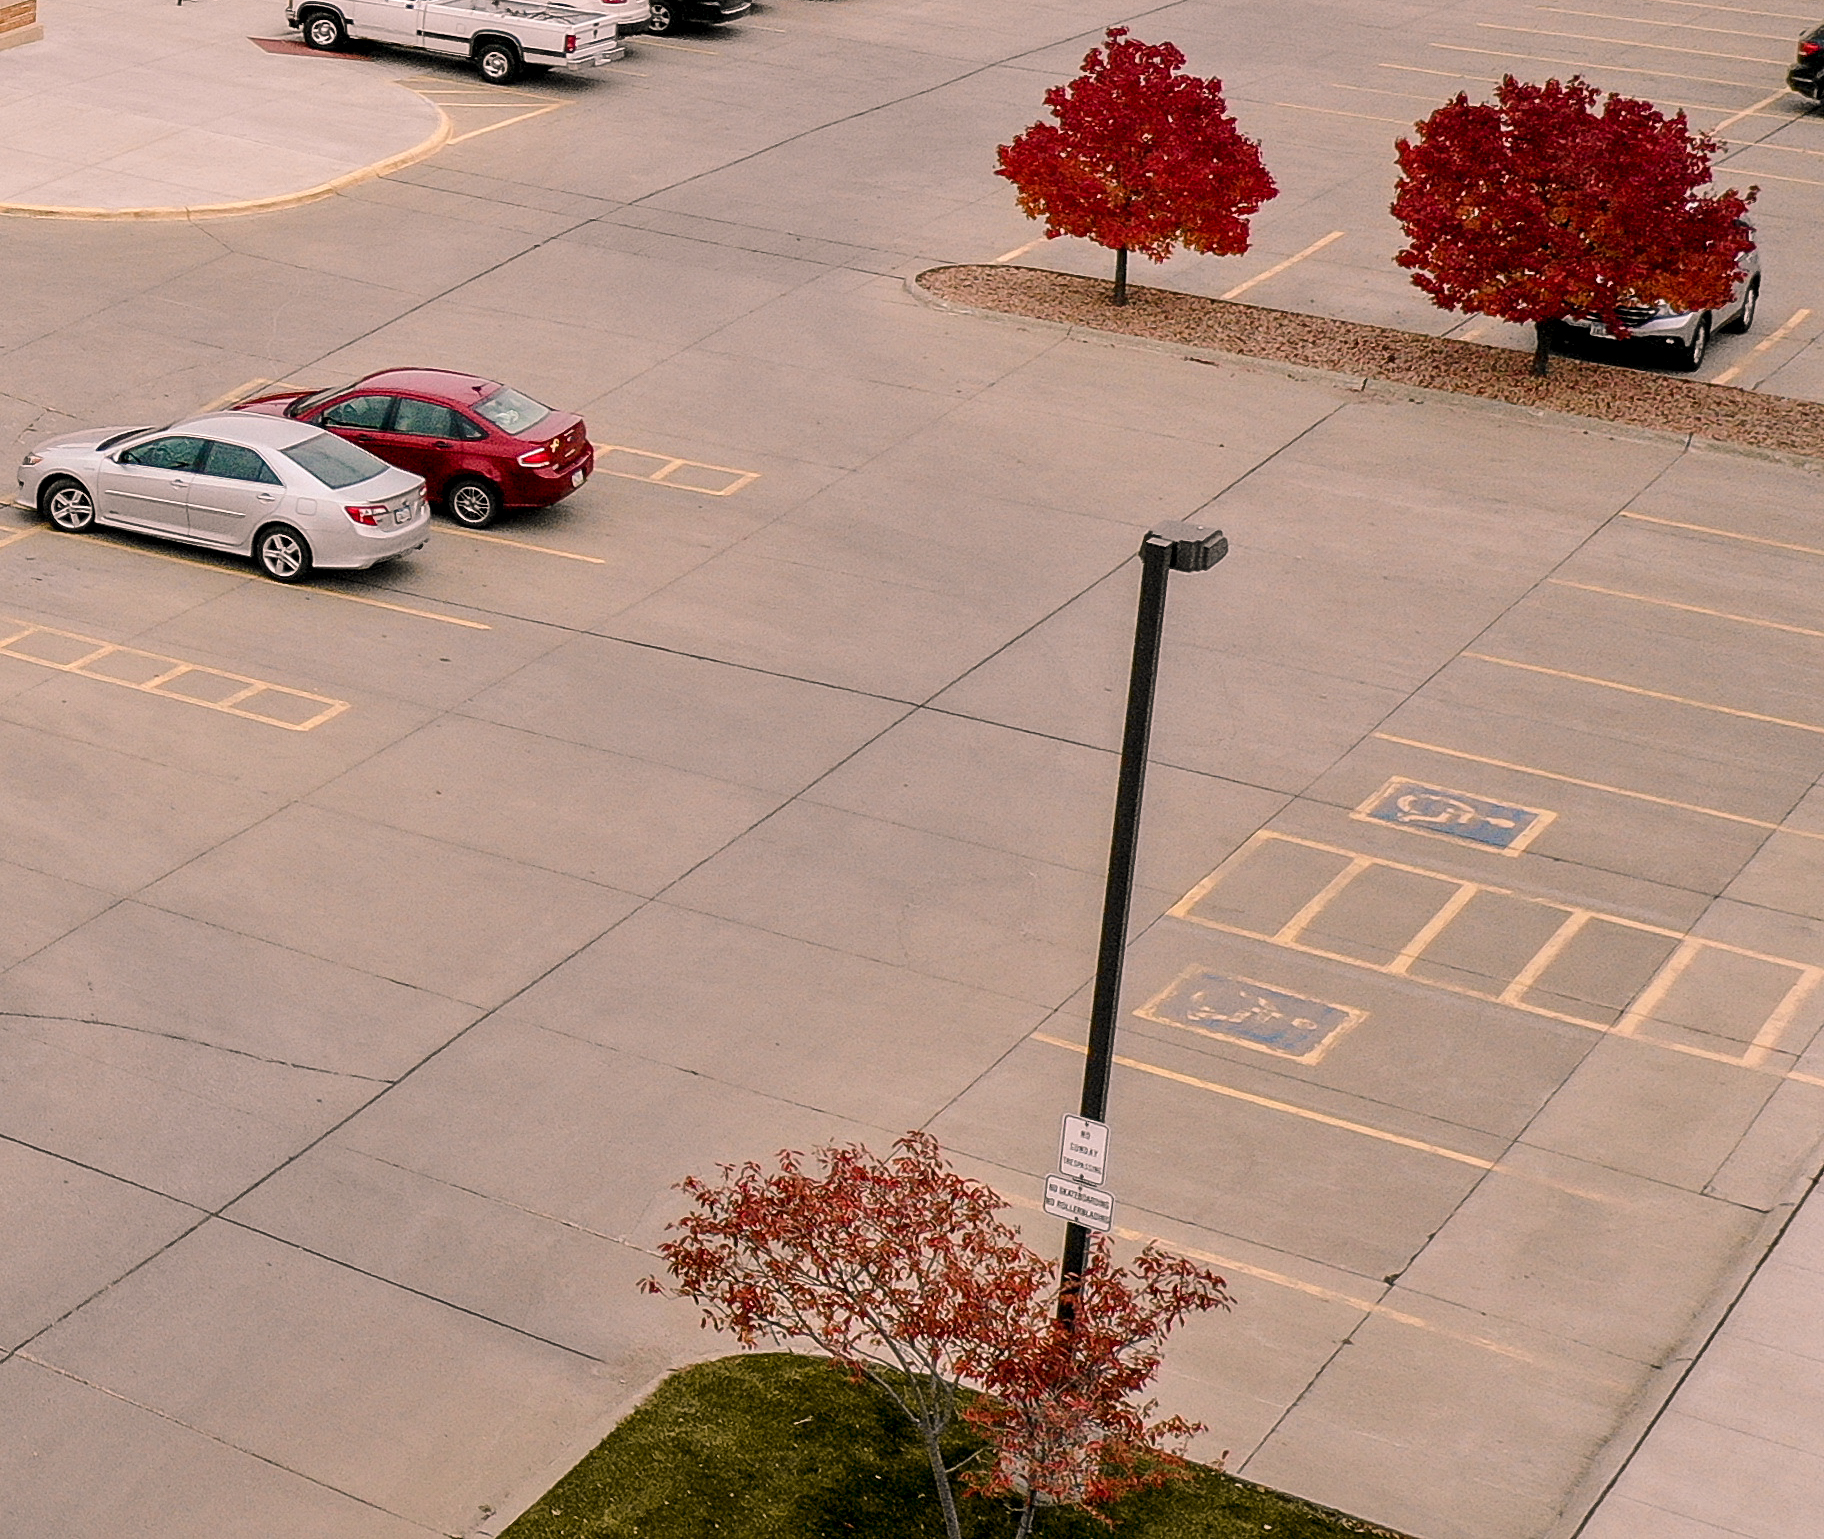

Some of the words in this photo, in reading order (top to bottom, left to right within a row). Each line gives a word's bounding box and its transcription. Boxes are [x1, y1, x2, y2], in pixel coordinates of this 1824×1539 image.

[1081, 1130, 1091, 1141] NO
[1070, 1141, 1099, 1158] SUNDAY
[1063, 1156, 1103, 1175] TRESPASSING
[1049, 1183, 1058, 1193] NO
[1059, 1186, 1110, 1210] SKATEBOARDING
[1045, 1197, 1055, 1207] NO
[1057, 1200, 1110, 1223] ROLLERBLADING
